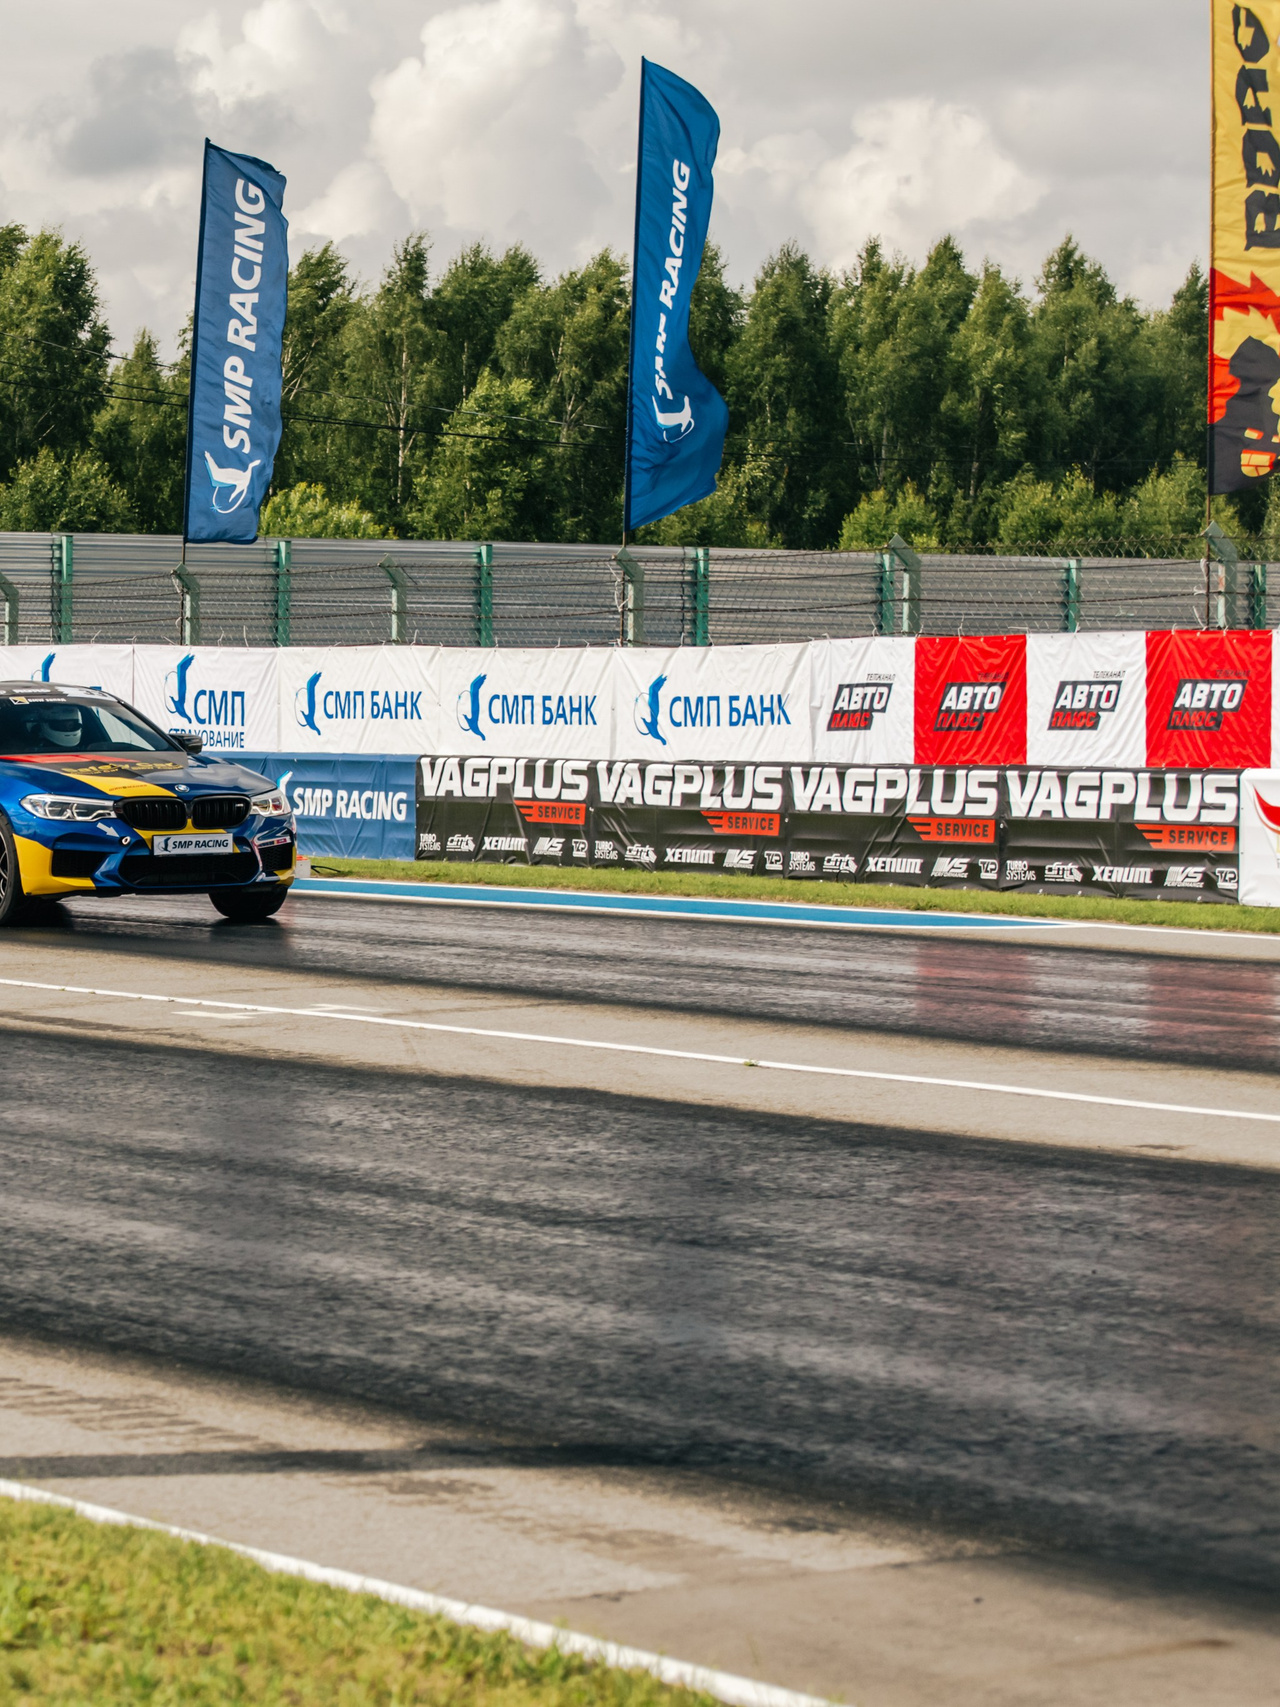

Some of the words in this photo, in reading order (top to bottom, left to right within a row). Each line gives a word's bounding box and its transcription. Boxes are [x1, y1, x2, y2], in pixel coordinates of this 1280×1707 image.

[1232, 3, 1280, 251] RDRC
[659, 158, 691, 310] RACING
[226, 177, 268, 353] RACING
[223, 355, 254, 454] SMP
[1092, 670, 1126, 679] ТЕЛЕКАНАЛ
[323, 690, 365, 719] СМП
[370, 690, 423, 720] БАНК
[834, 686, 890, 712] АВТО
[941, 685, 1002, 711] АВТО
[1055, 684, 1119, 709] АВТО
[1174, 683, 1243, 709] АВТО
[193, 689, 245, 727] СМП
[488, 694, 534, 725] СМП
[541, 695, 597, 726] БАНК
[669, 695, 720, 727] СМП
[728, 694, 792, 727] БАНК
[830, 712, 870, 728] ПЛЮС
[936, 712, 980, 728] ПЛЮС
[1051, 711, 1097, 728] ПЛЮС
[1170, 711, 1218, 727] ПЛЮС
[420, 757, 591, 800] VAGPLUS
[596, 760, 783, 811] VAGPLUS
[790, 767, 999, 816] VAGPLUS
[1004, 770, 1239, 823] VAGPLUS
[293, 787, 332, 817] SMP
[335, 790, 407, 821] RACING
[537, 805, 581, 821] SERVICE
[727, 816, 774, 832] SERVICE
[935, 821, 990, 838] SERVICE
[172, 840, 193, 849] SMP
[194, 838, 229, 848] RACING
[482, 836, 528, 851] XENUM
[595, 840, 613, 851] TURBO
[1168, 828, 1228, 847] SERVICE
[594, 850, 619, 860] SYSTEMS
[664, 848, 716, 864] XENUM
[790, 851, 810, 861] TURBO
[789, 860, 816, 871] SYSTEMS
[866, 857, 924, 874] XENUM
[1006, 860, 1028, 870] TURBO
[1092, 865, 1153, 883] XENUM
[1006, 869, 1036, 881] SYSTEMS
